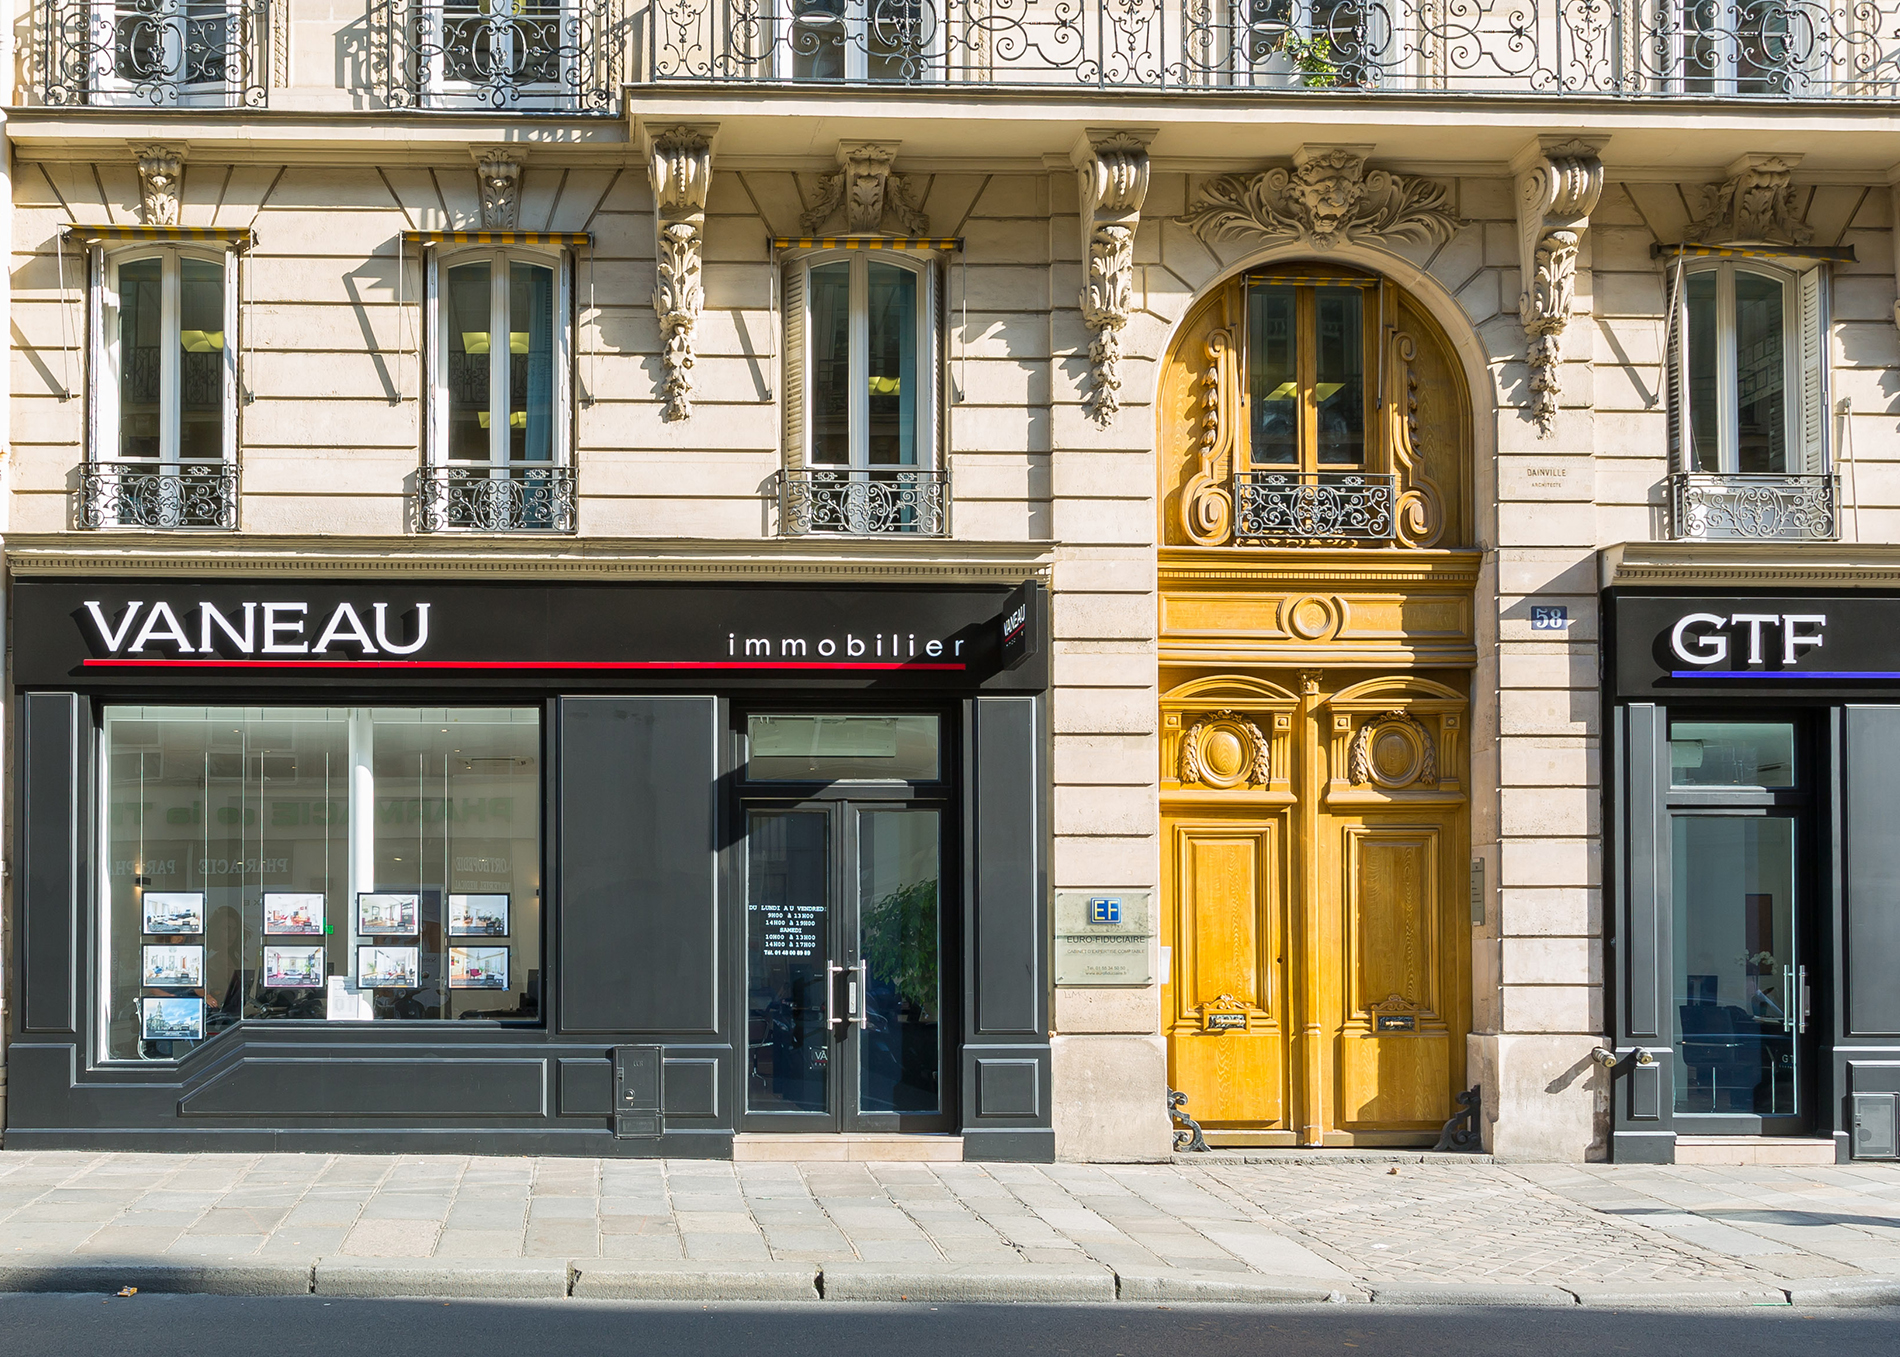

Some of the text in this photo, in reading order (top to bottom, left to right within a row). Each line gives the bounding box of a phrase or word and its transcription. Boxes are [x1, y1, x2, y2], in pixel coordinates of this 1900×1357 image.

[1527, 468, 1567, 477] DAINVILLE
[83, 600, 431, 655] VANEAU
[1003, 603, 1026, 637] VANEAU
[1536, 608, 1562, 629] 58
[728, 632, 965, 657] immobilier
[1671, 613, 1826, 665] GTF
[1094, 900, 1118, 920] EF
[1066, 935, 1145, 943] EURO-FIDUCIAIRE
